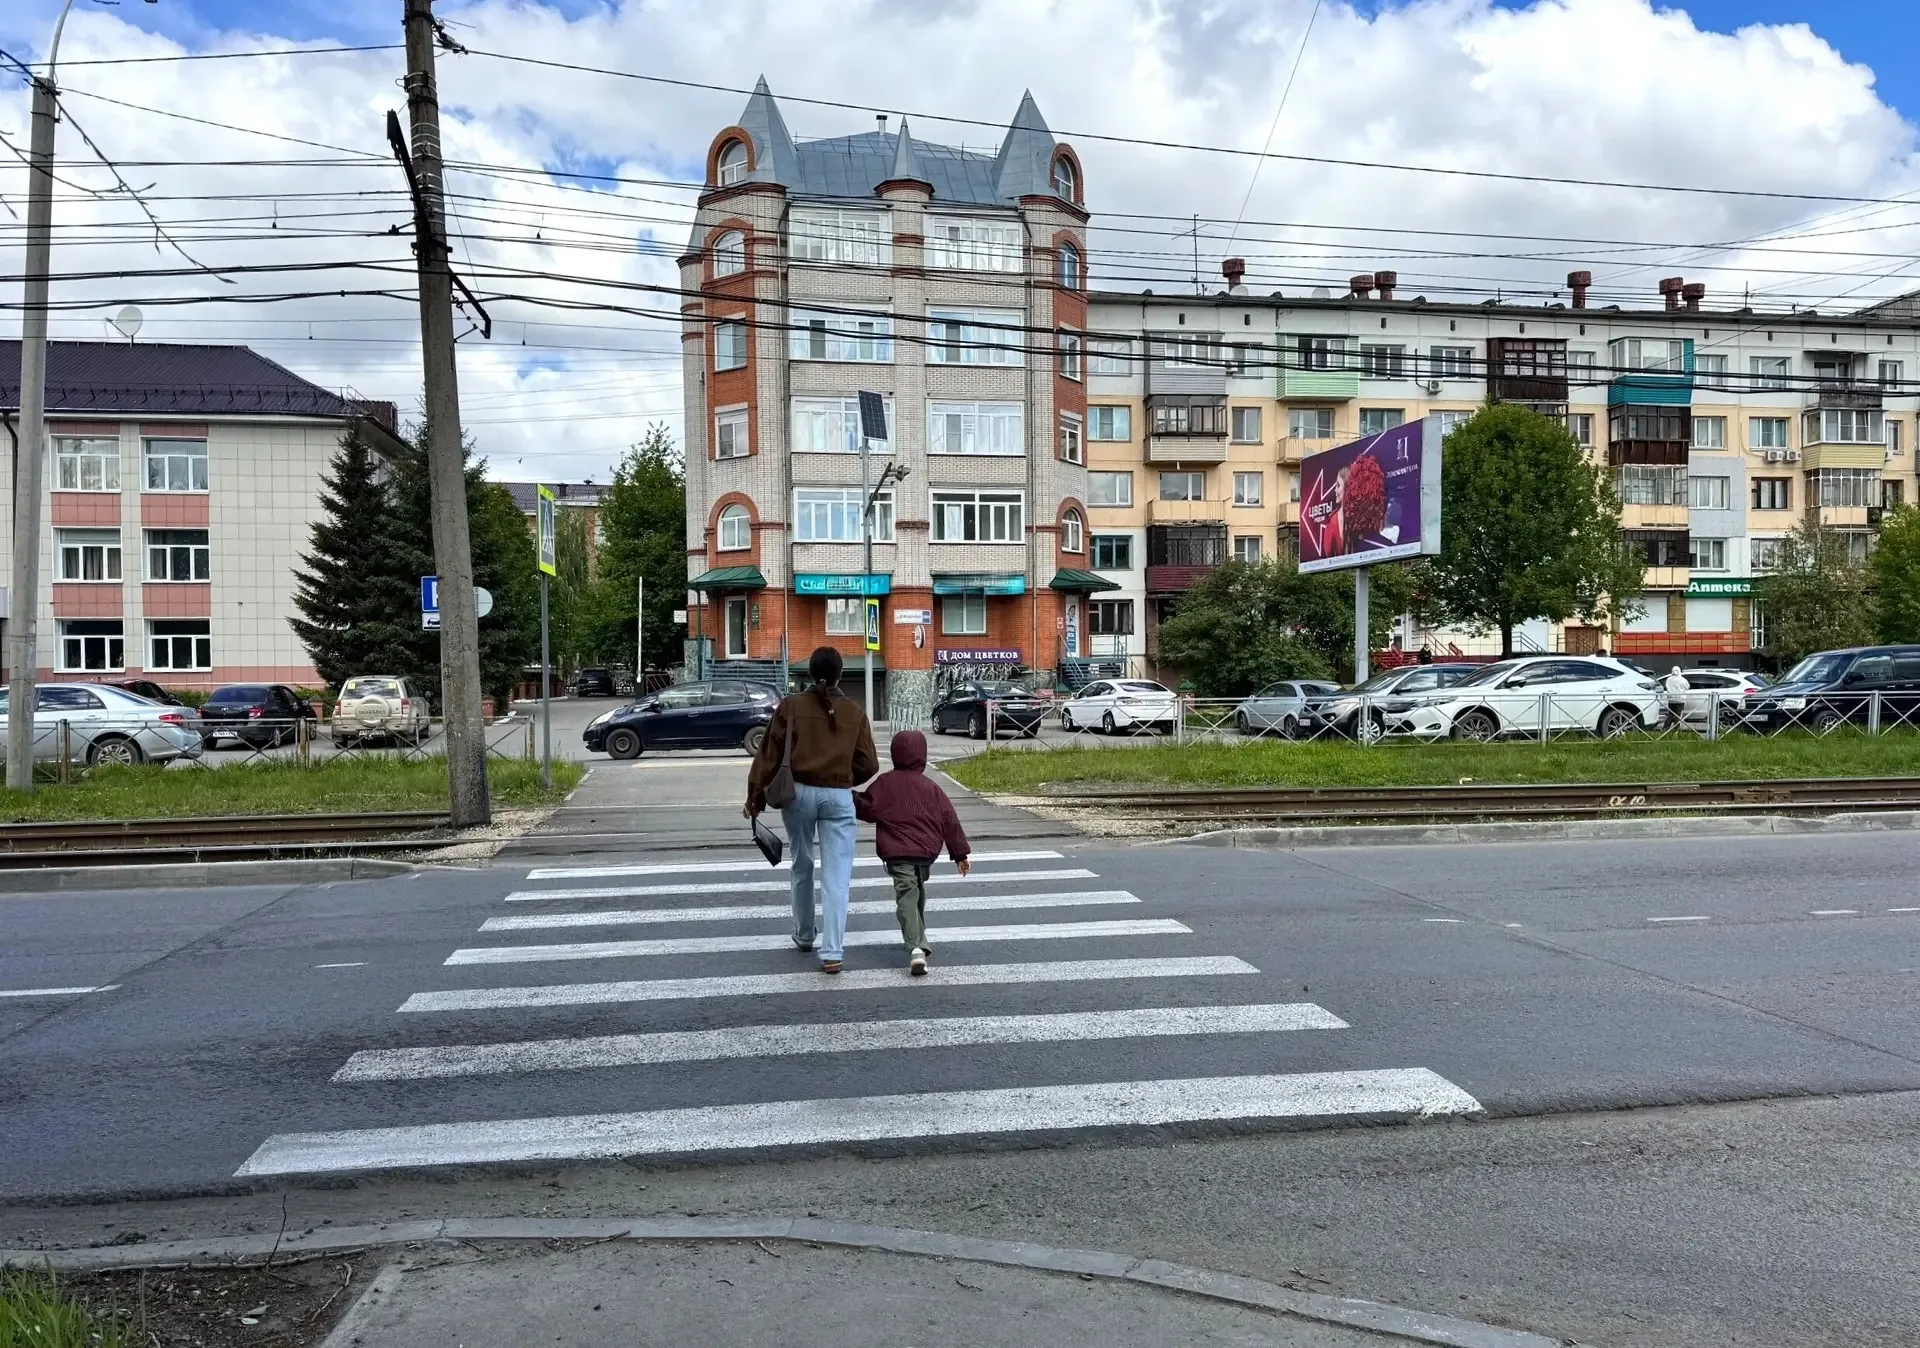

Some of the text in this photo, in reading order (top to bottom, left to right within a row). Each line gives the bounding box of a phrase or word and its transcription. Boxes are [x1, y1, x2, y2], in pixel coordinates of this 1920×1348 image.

[1308, 501, 1333, 519] ЦВЕТЫ
[1688, 582, 1751, 592] Аптека
[950, 652, 971, 660] ДОМ
[975, 652, 1018, 660] ЦВЕТКОВ
